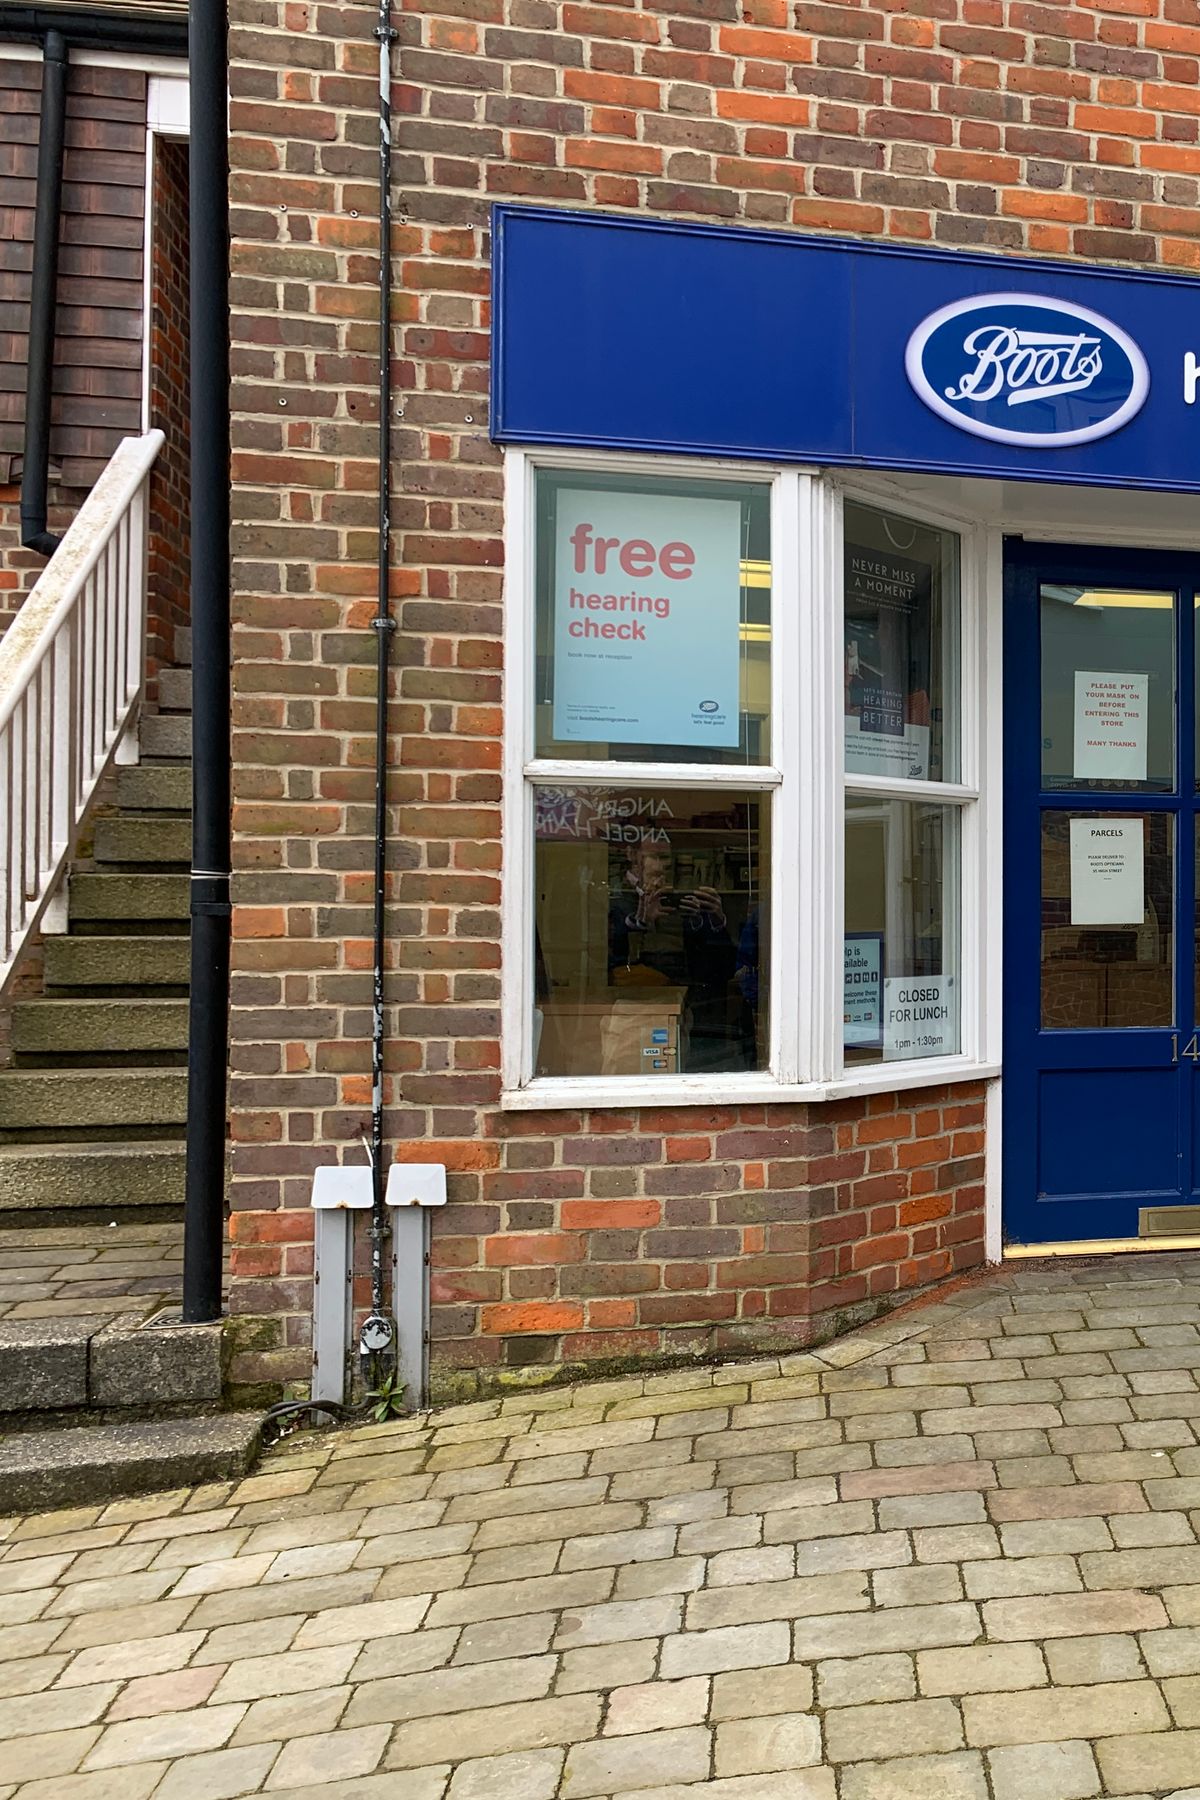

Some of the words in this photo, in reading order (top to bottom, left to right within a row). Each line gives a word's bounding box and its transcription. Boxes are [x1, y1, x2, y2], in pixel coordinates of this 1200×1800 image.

[944, 325, 1103, 407] Boots
[569, 523, 696, 580] free
[852, 558, 888, 576] NEVER
[892, 568, 916, 584] MISS
[854, 577, 861, 588] A
[866, 580, 913, 600] MOMENT
[569, 587, 670, 618] hearing
[568, 617, 646, 640] check
[863, 695, 903, 710] HEARING
[863, 711, 902, 727] BETTER
[1091, 829, 1123, 837] PARCELS
[854, 946, 860, 955] is
[898, 988, 940, 1003] CLOSED
[889, 1009, 911, 1023] FOR
[913, 1006, 948, 1021] LUNCH
[894, 1040, 911, 1051] 1pm
[917, 1035, 943, 1048] 1:30pm
[1170, 1033, 1200, 1061] 14
